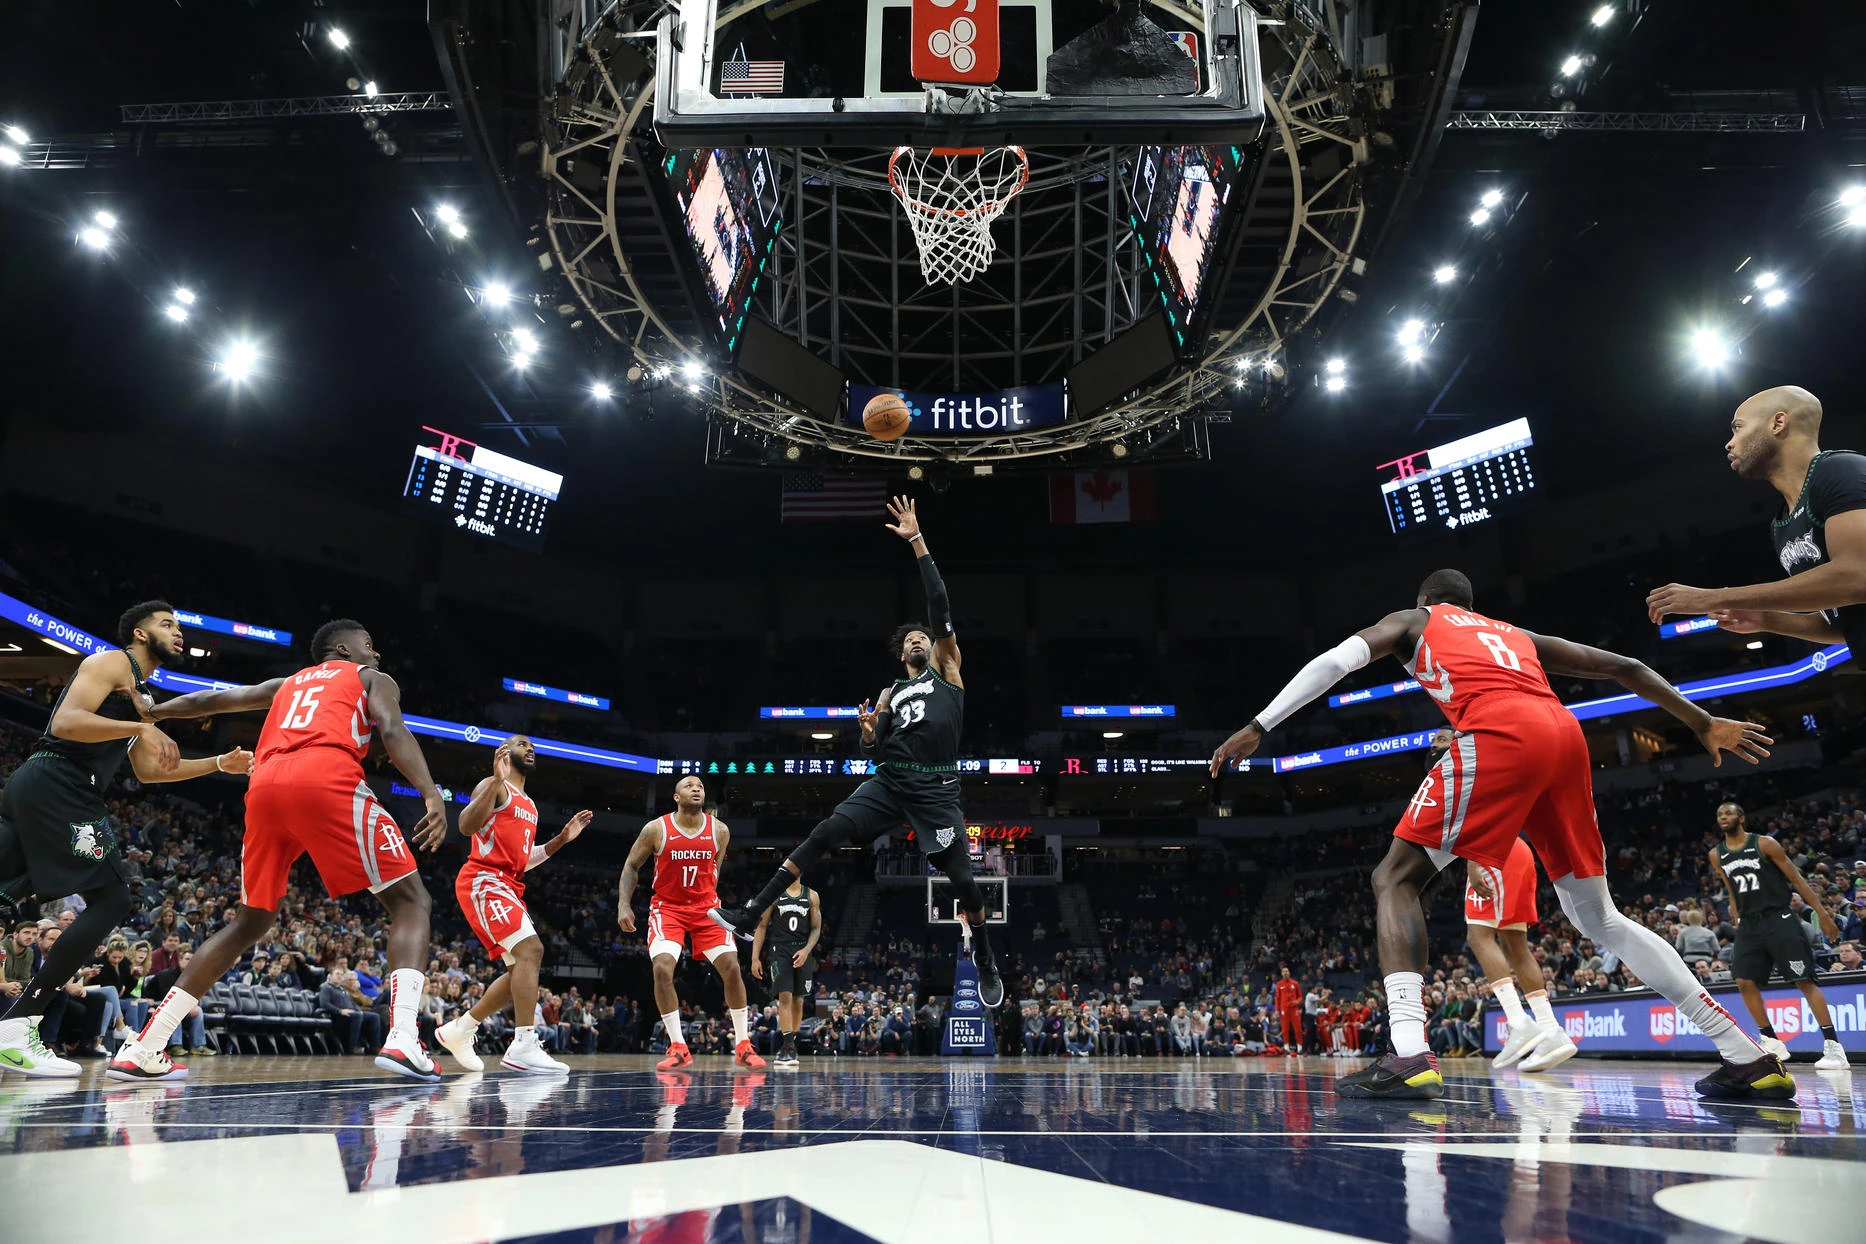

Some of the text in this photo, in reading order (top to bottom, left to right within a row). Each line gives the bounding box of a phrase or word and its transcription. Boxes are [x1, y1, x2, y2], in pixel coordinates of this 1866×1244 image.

[173, 610, 202, 625] bank
[27, 612, 44, 627] the
[47, 620, 93, 650] POWER
[233, 624, 276, 640] usbank
[1477, 632, 1522, 672] 8
[1340, 690, 1372, 703] usbank
[280, 686, 324, 728] 15
[772, 708, 804, 716] usbank
[900, 700, 926, 728] 33
[1074, 706, 1107, 715] usbank
[1130, 706, 1164, 714] usbank
[1346, 747, 1360, 757] the
[1364, 737, 1408, 754] POWER
[1414, 734, 1424, 746] of
[957, 760, 980, 770] 1:09
[1000, 761, 1006, 770] 2
[1281, 752, 1322, 769] usbank
[514, 804, 537, 826] ROCKET
[522, 828, 530, 854] 3
[670, 850, 712, 860] ROCKETS
[682, 866, 698, 888] 17
[1732, 872, 1760, 894] 22
[789, 916, 798, 932] 0
[1565, 1008, 1626, 1037] usbank
